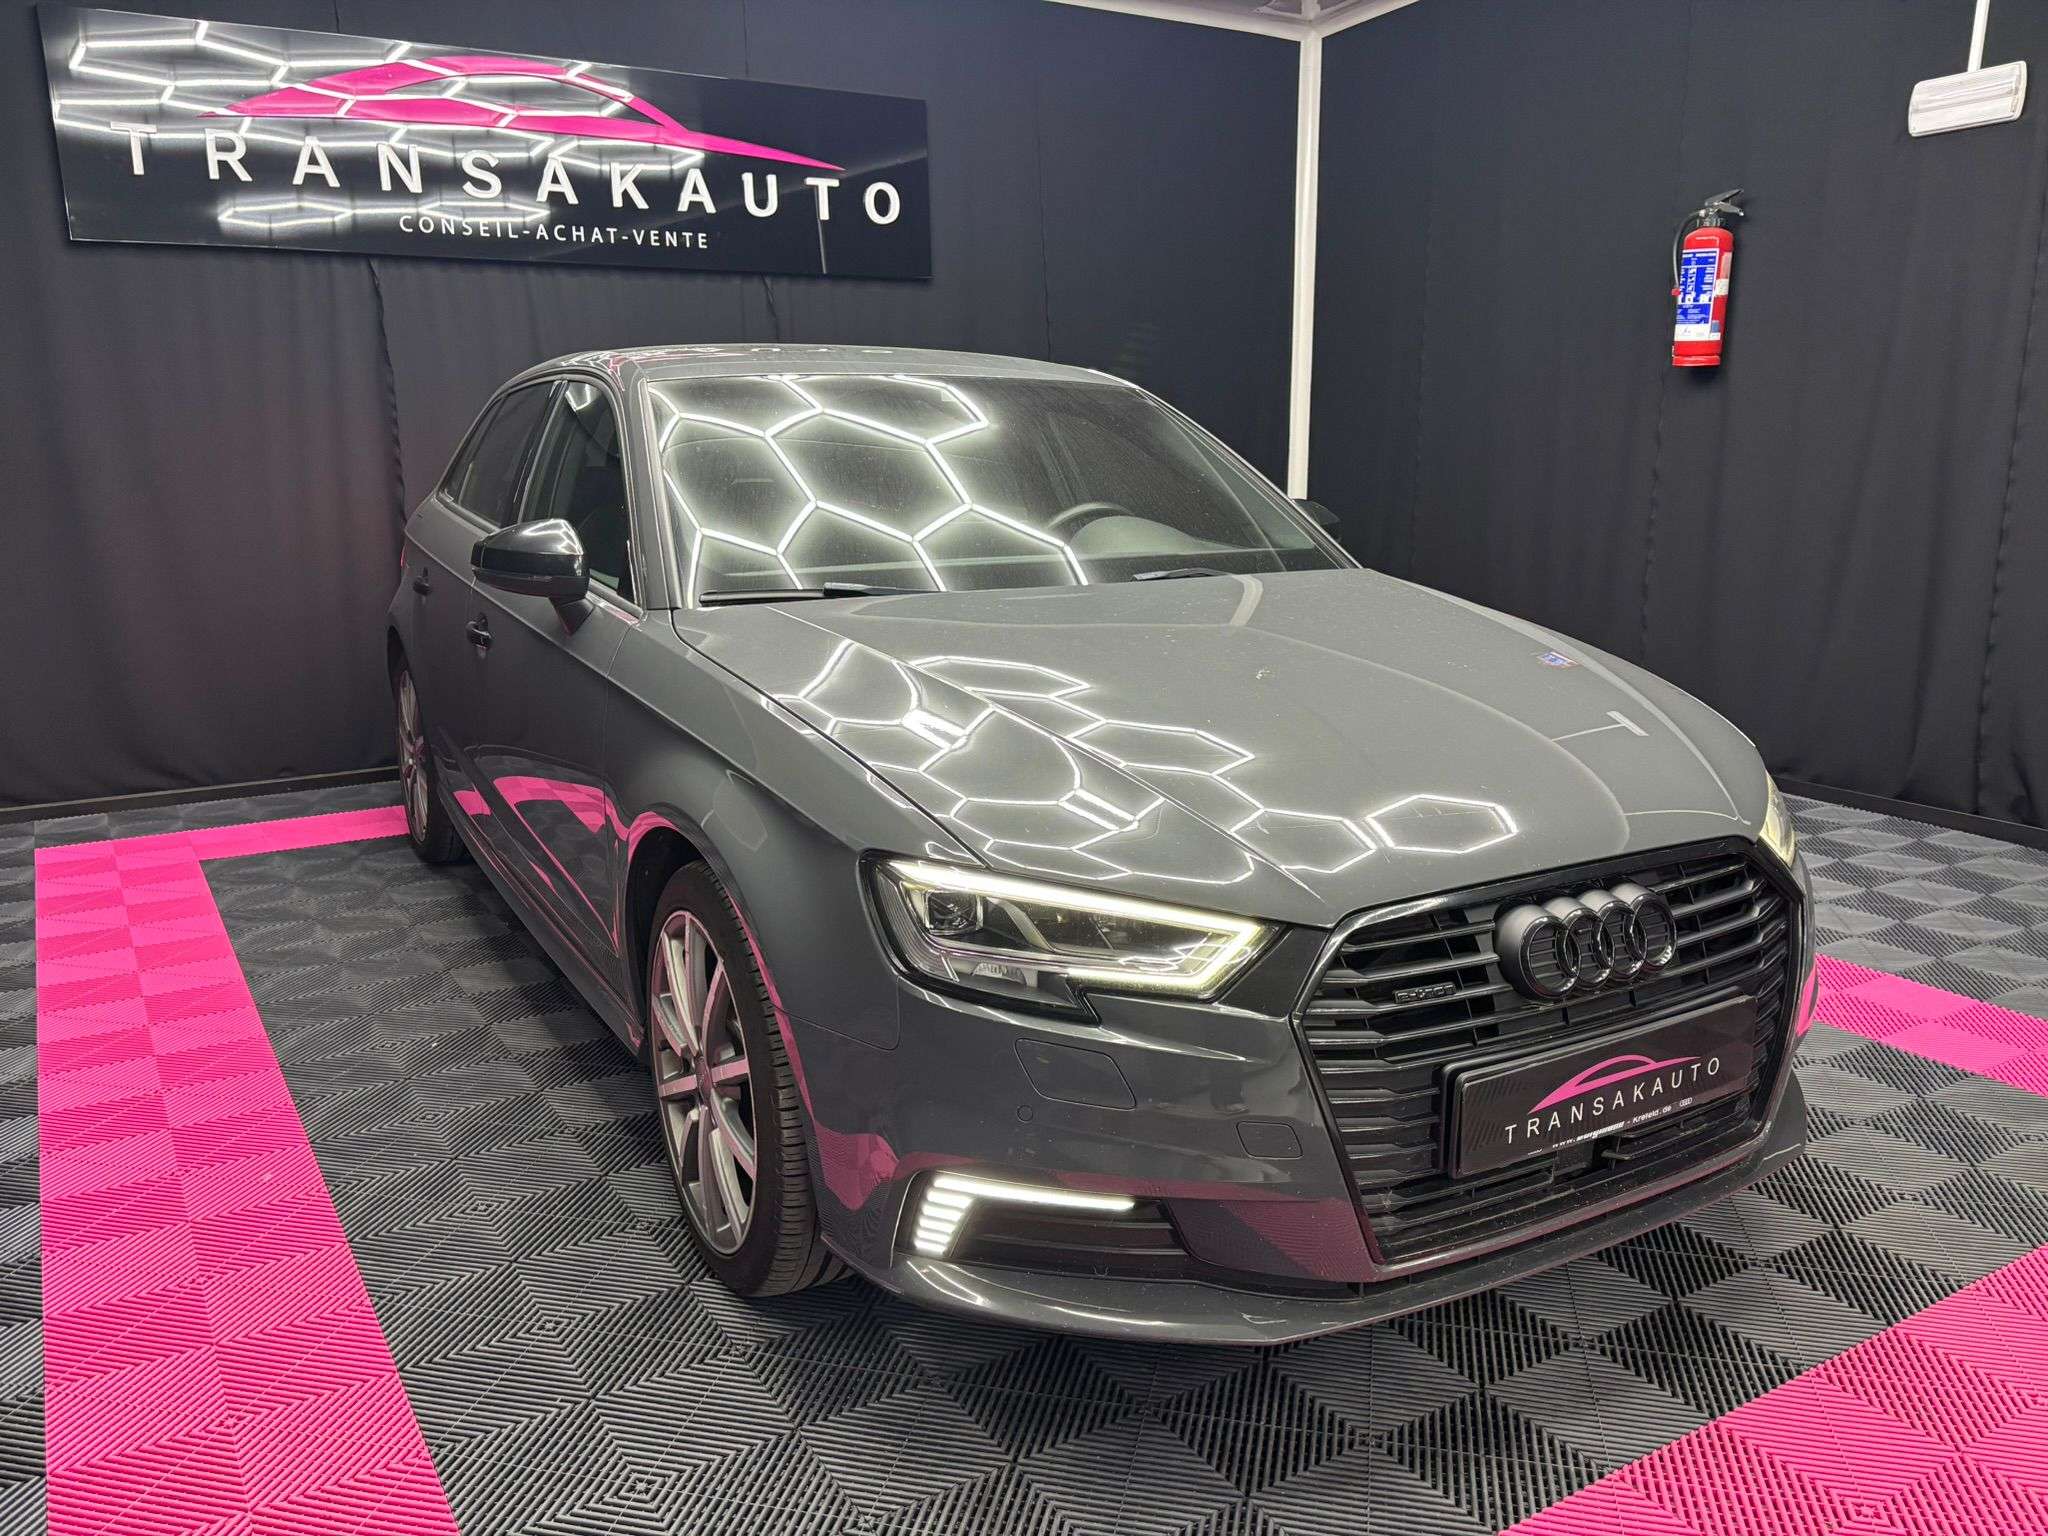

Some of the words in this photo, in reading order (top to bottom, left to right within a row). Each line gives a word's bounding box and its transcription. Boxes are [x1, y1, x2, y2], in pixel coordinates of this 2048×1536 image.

[110, 121, 902, 226] TRANSAKAUTO
[399, 214, 709, 250] CONSEIL-ACHAT-VENTE
[1504, 1056, 1721, 1145] TRANSAKAUTO
